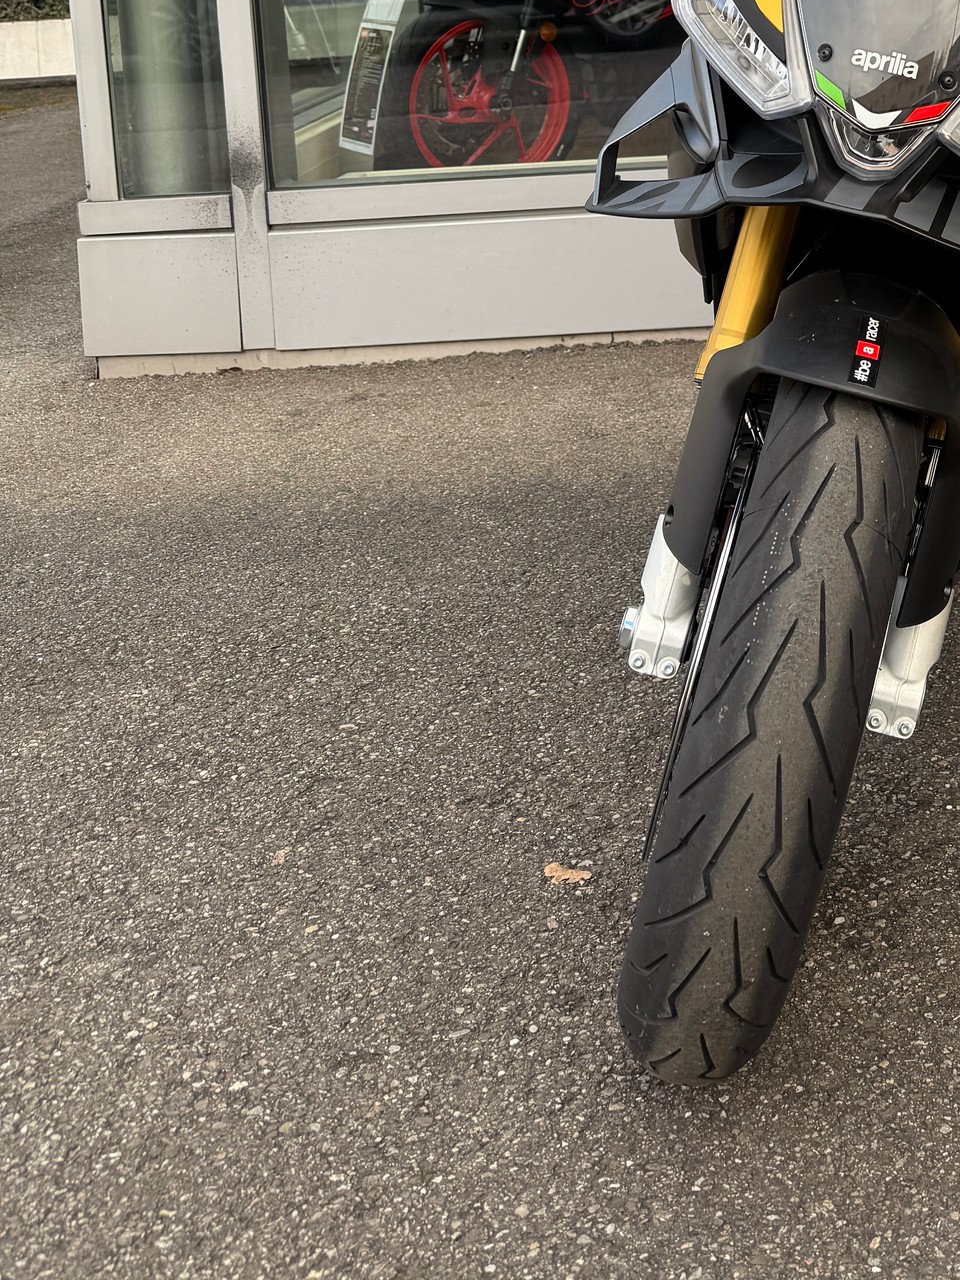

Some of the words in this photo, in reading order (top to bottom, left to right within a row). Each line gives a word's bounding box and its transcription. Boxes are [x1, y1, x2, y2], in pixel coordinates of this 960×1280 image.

[851, 48, 919, 79] aprilia
[866, 317, 880, 342] racer
[862, 346, 875, 355] a
[853, 359, 872, 382] #be
